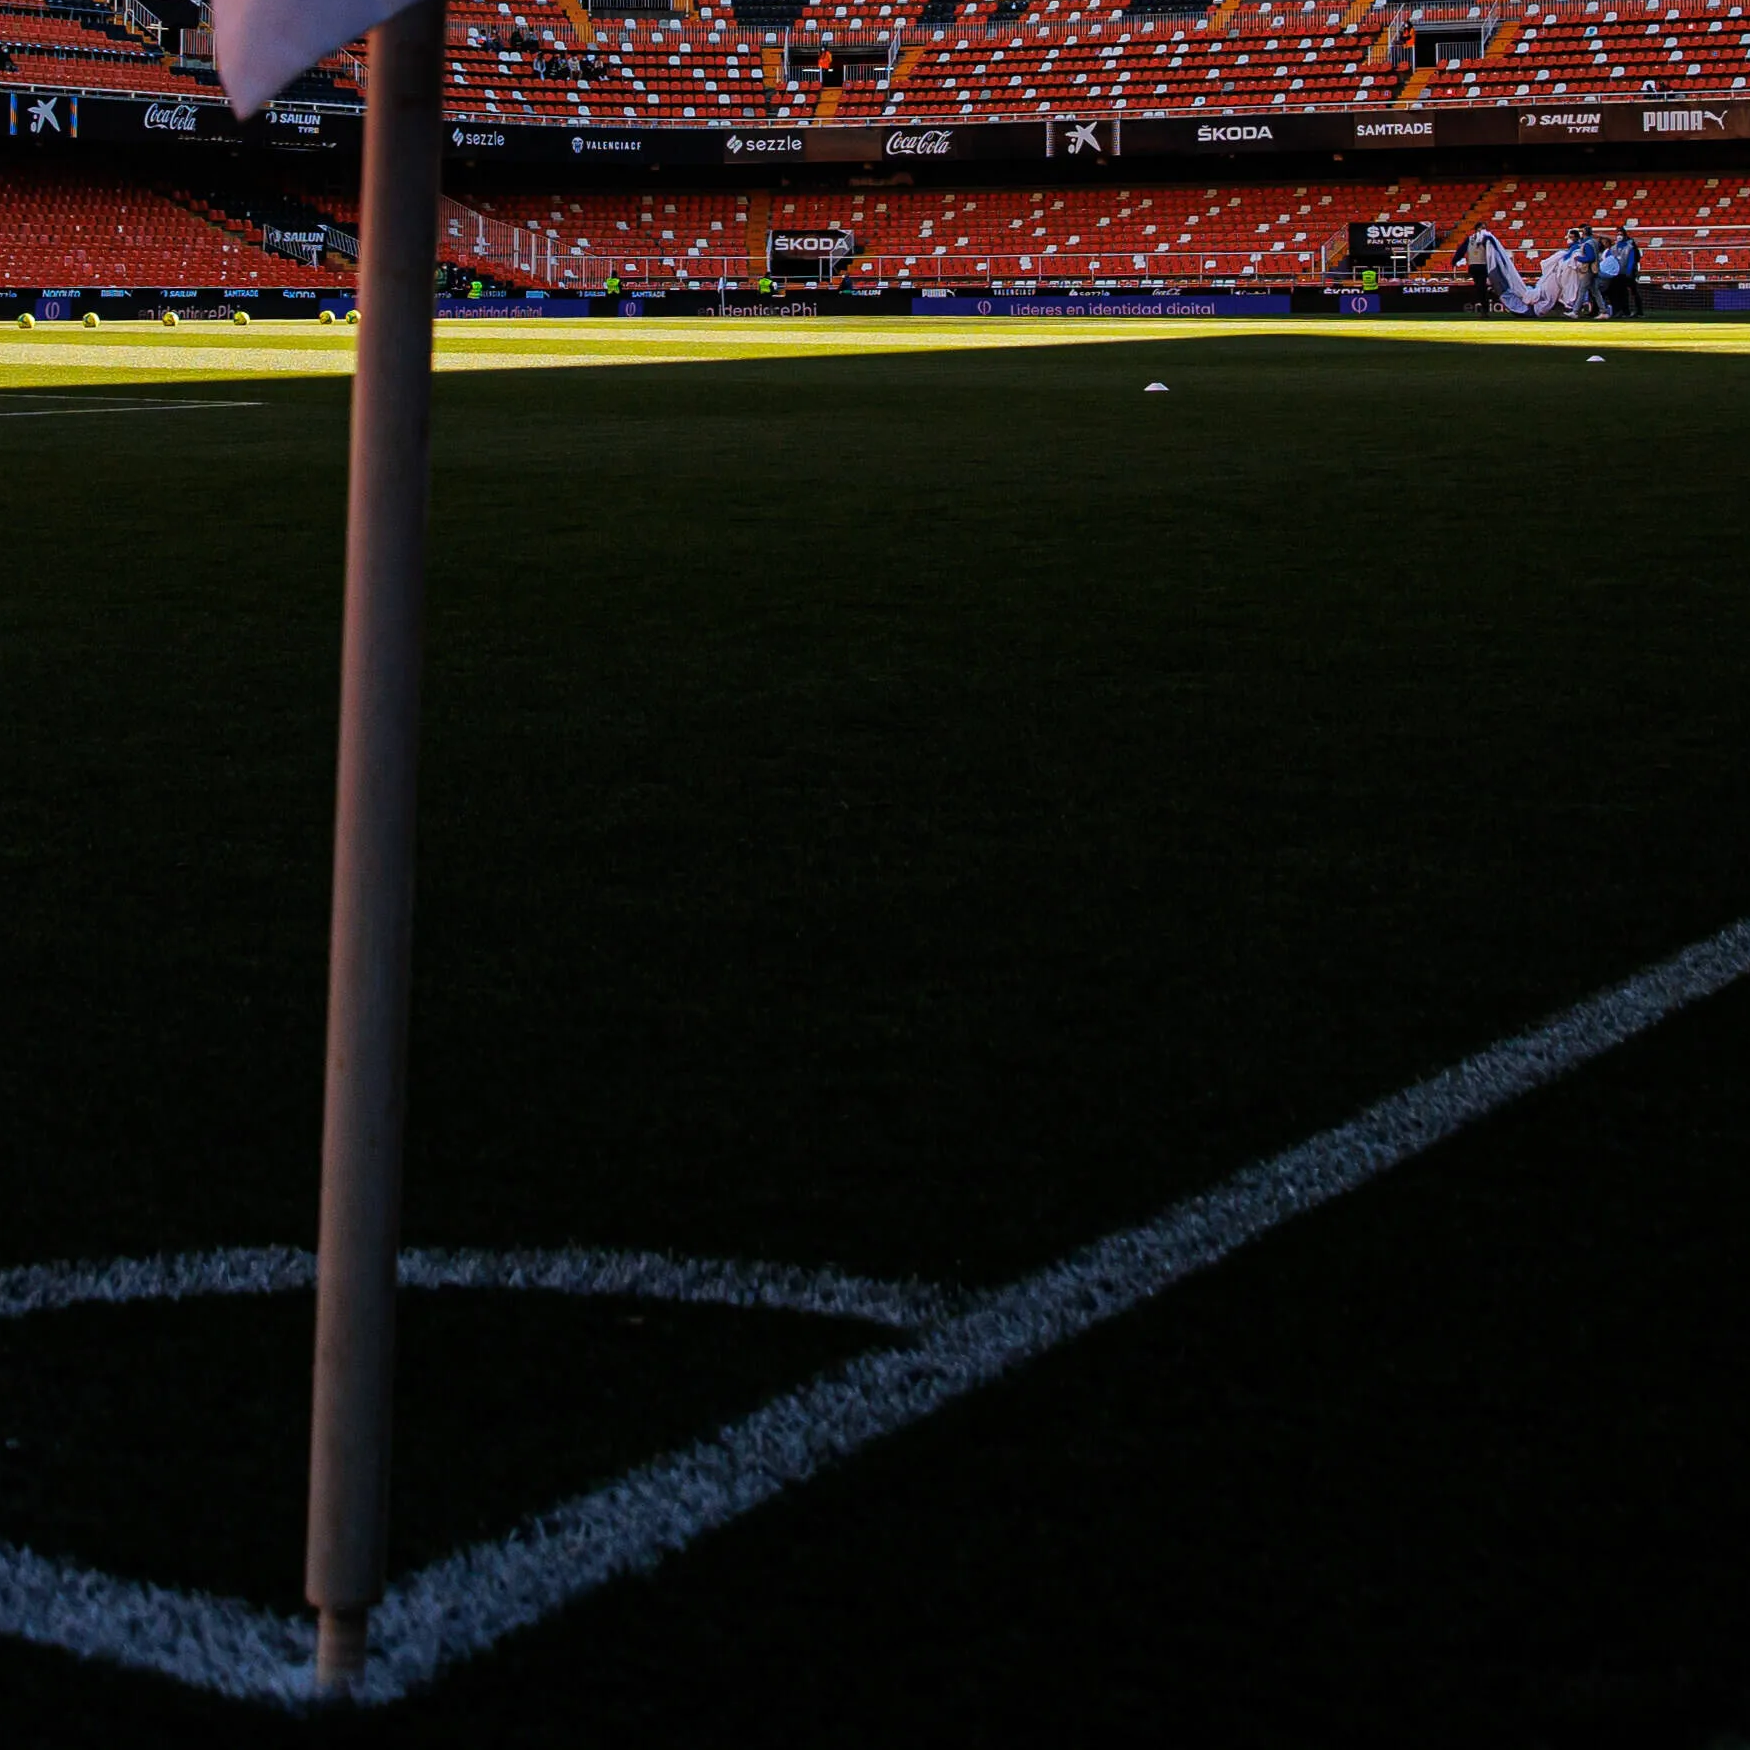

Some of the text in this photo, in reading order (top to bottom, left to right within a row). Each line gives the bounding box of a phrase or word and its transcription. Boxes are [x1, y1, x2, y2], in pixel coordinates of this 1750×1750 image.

[143, 102, 199, 132] Coca-Cola
[279, 112, 321, 126] SAILUN
[1539, 113, 1601, 126] SAILUN
[1643, 110, 1708, 131] PUMA
[1197, 126, 1274, 142] ŠKODA
[1356, 122, 1433, 136] SAMTRADE
[1567, 125, 1599, 134] TYRE
[465, 129, 505, 147] sezzle
[746, 137, 802, 152] sezzle
[885, 130, 954, 155] Coca-Cola
[283, 231, 325, 243] SAILUN
[1366, 225, 1415, 239] $VCF
[774, 234, 850, 252] ŠKODA
[223, 289, 259, 299] SAMTRADE
[1403, 286, 1450, 295] SAMTRADE
[1010, 302, 1216, 316] Líderes en identidad digital
